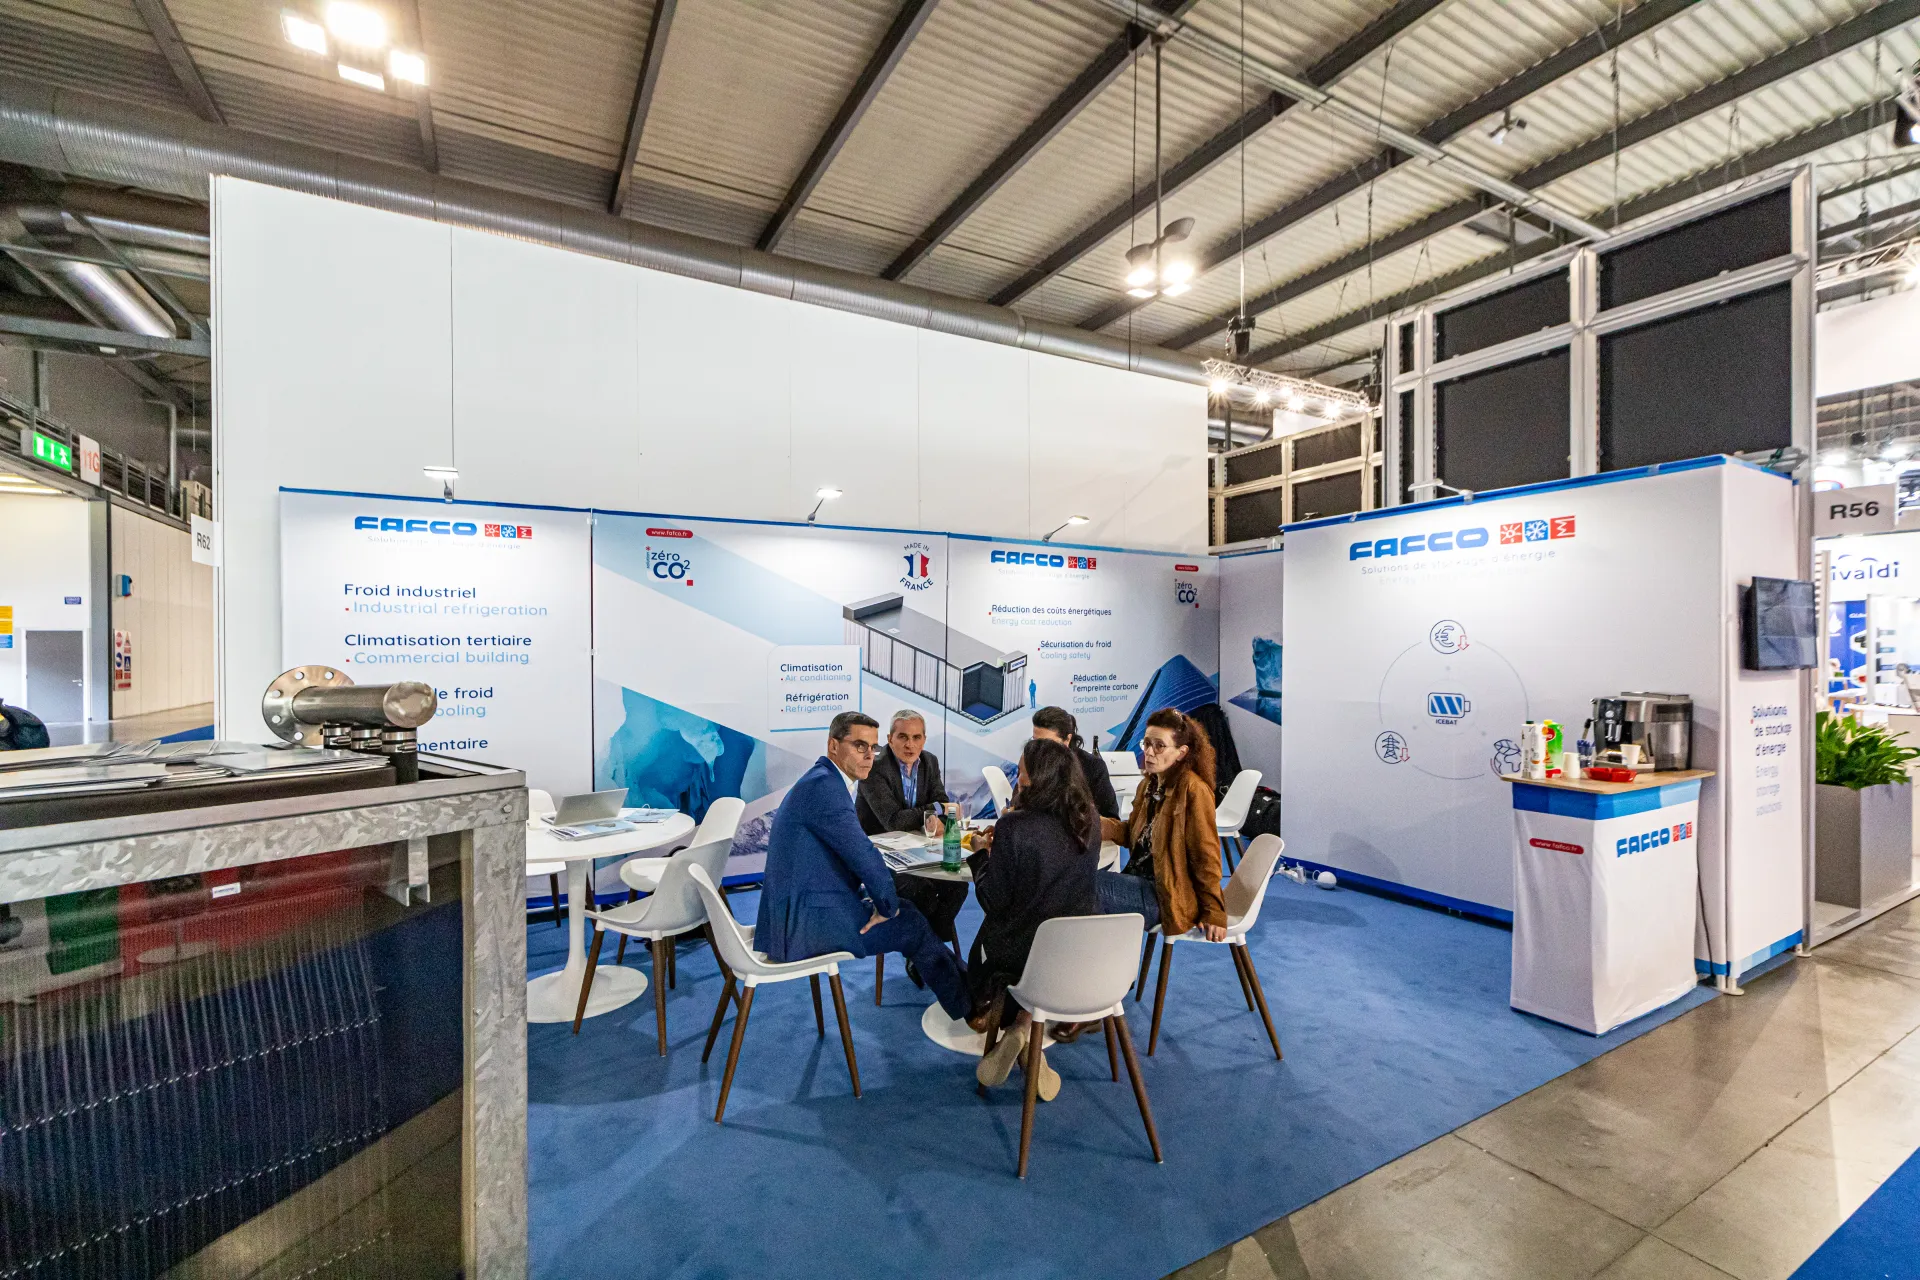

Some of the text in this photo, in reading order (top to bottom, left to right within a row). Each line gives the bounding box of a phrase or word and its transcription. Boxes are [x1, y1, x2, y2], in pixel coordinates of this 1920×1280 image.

[1830, 501, 1880, 520] R56
[354, 516, 477, 536] FAFCO
[196, 532, 211, 551] R62
[903, 542, 922, 551] MADE
[1349, 527, 1490, 561] FAFCO
[651, 550, 680, 561] zéro
[990, 550, 1065, 568] FAFCO
[1361, 562, 1409, 575] Solutions
[899, 577, 934, 591] FRANCE
[1177, 581, 1193, 589] zéro
[344, 583, 476, 599] Froid industriel
[353, 601, 548, 618] Industrial refrigeration
[991, 604, 1112, 618] Réduction des coûts énergétiques
[991, 617, 1019, 627] Energy
[1038, 618, 1072, 626] reduction
[344, 634, 532, 647] Climatisation tertiaire
[1040, 640, 1112, 648] Sécurisation du froid
[354, 651, 530, 666] Commercial building
[1040, 652, 1091, 660] Cooling safety
[780, 663, 843, 672] Climatisation
[785, 673, 852, 682] Air conditioning
[1073, 673, 1117, 682] Réduction de
[454, 687, 494, 700] froid
[1072, 683, 1139, 693] l'empreinte carbone
[785, 693, 849, 704] Réfrigération
[1072, 694, 1128, 704] Carbon footprint
[435, 705, 487, 719] ooling
[785, 704, 843, 714] Refrigeration
[1072, 706, 1105, 714] reduction
[1752, 703, 1788, 718] Solutions
[1435, 718, 1458, 726] ICEBAT
[1753, 724, 1764, 737] de
[1755, 741, 1787, 757] d'énergie
[1616, 827, 1670, 858] FAFCO
